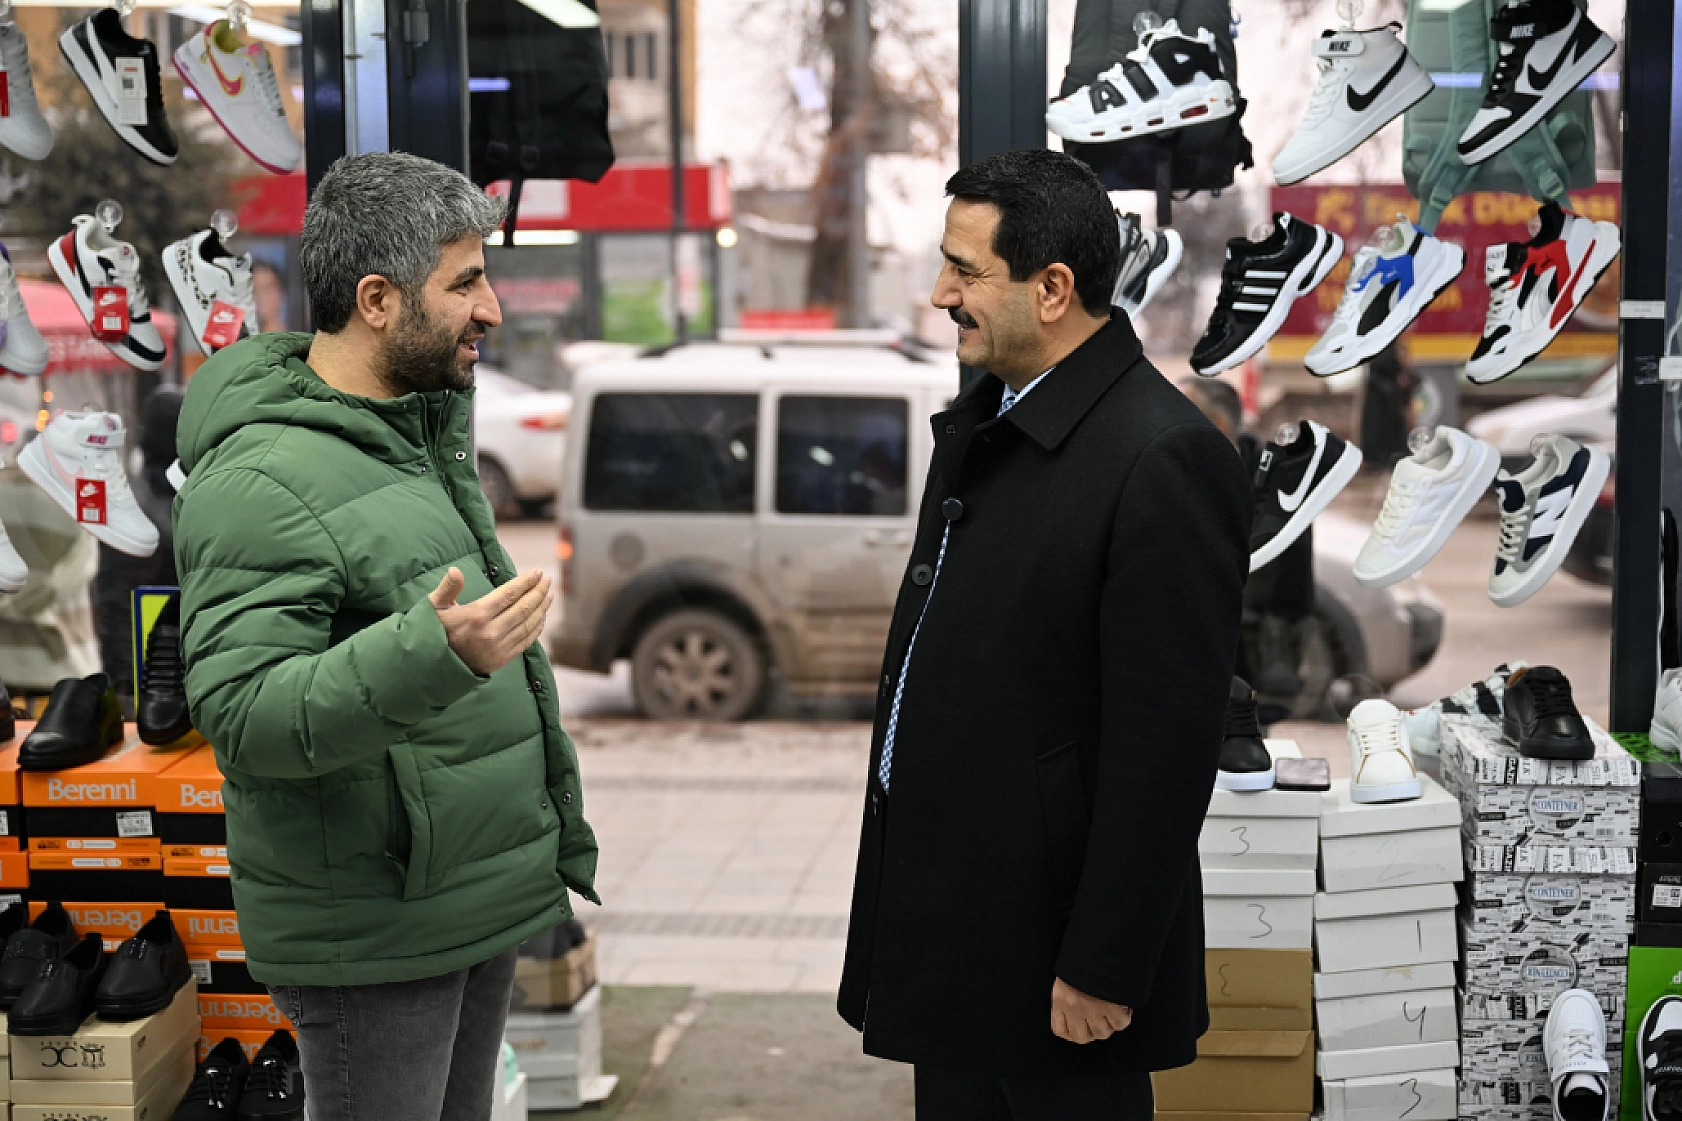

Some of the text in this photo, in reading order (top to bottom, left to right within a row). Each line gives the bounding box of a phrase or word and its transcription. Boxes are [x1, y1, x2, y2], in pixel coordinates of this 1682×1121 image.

[48, 778, 136, 801] Berenni
[1230, 826, 1250, 857] 3
[1246, 903, 1273, 939] 3
[200, 1001, 281, 1024] Berenn
[1399, 1078, 1422, 1119] 3
